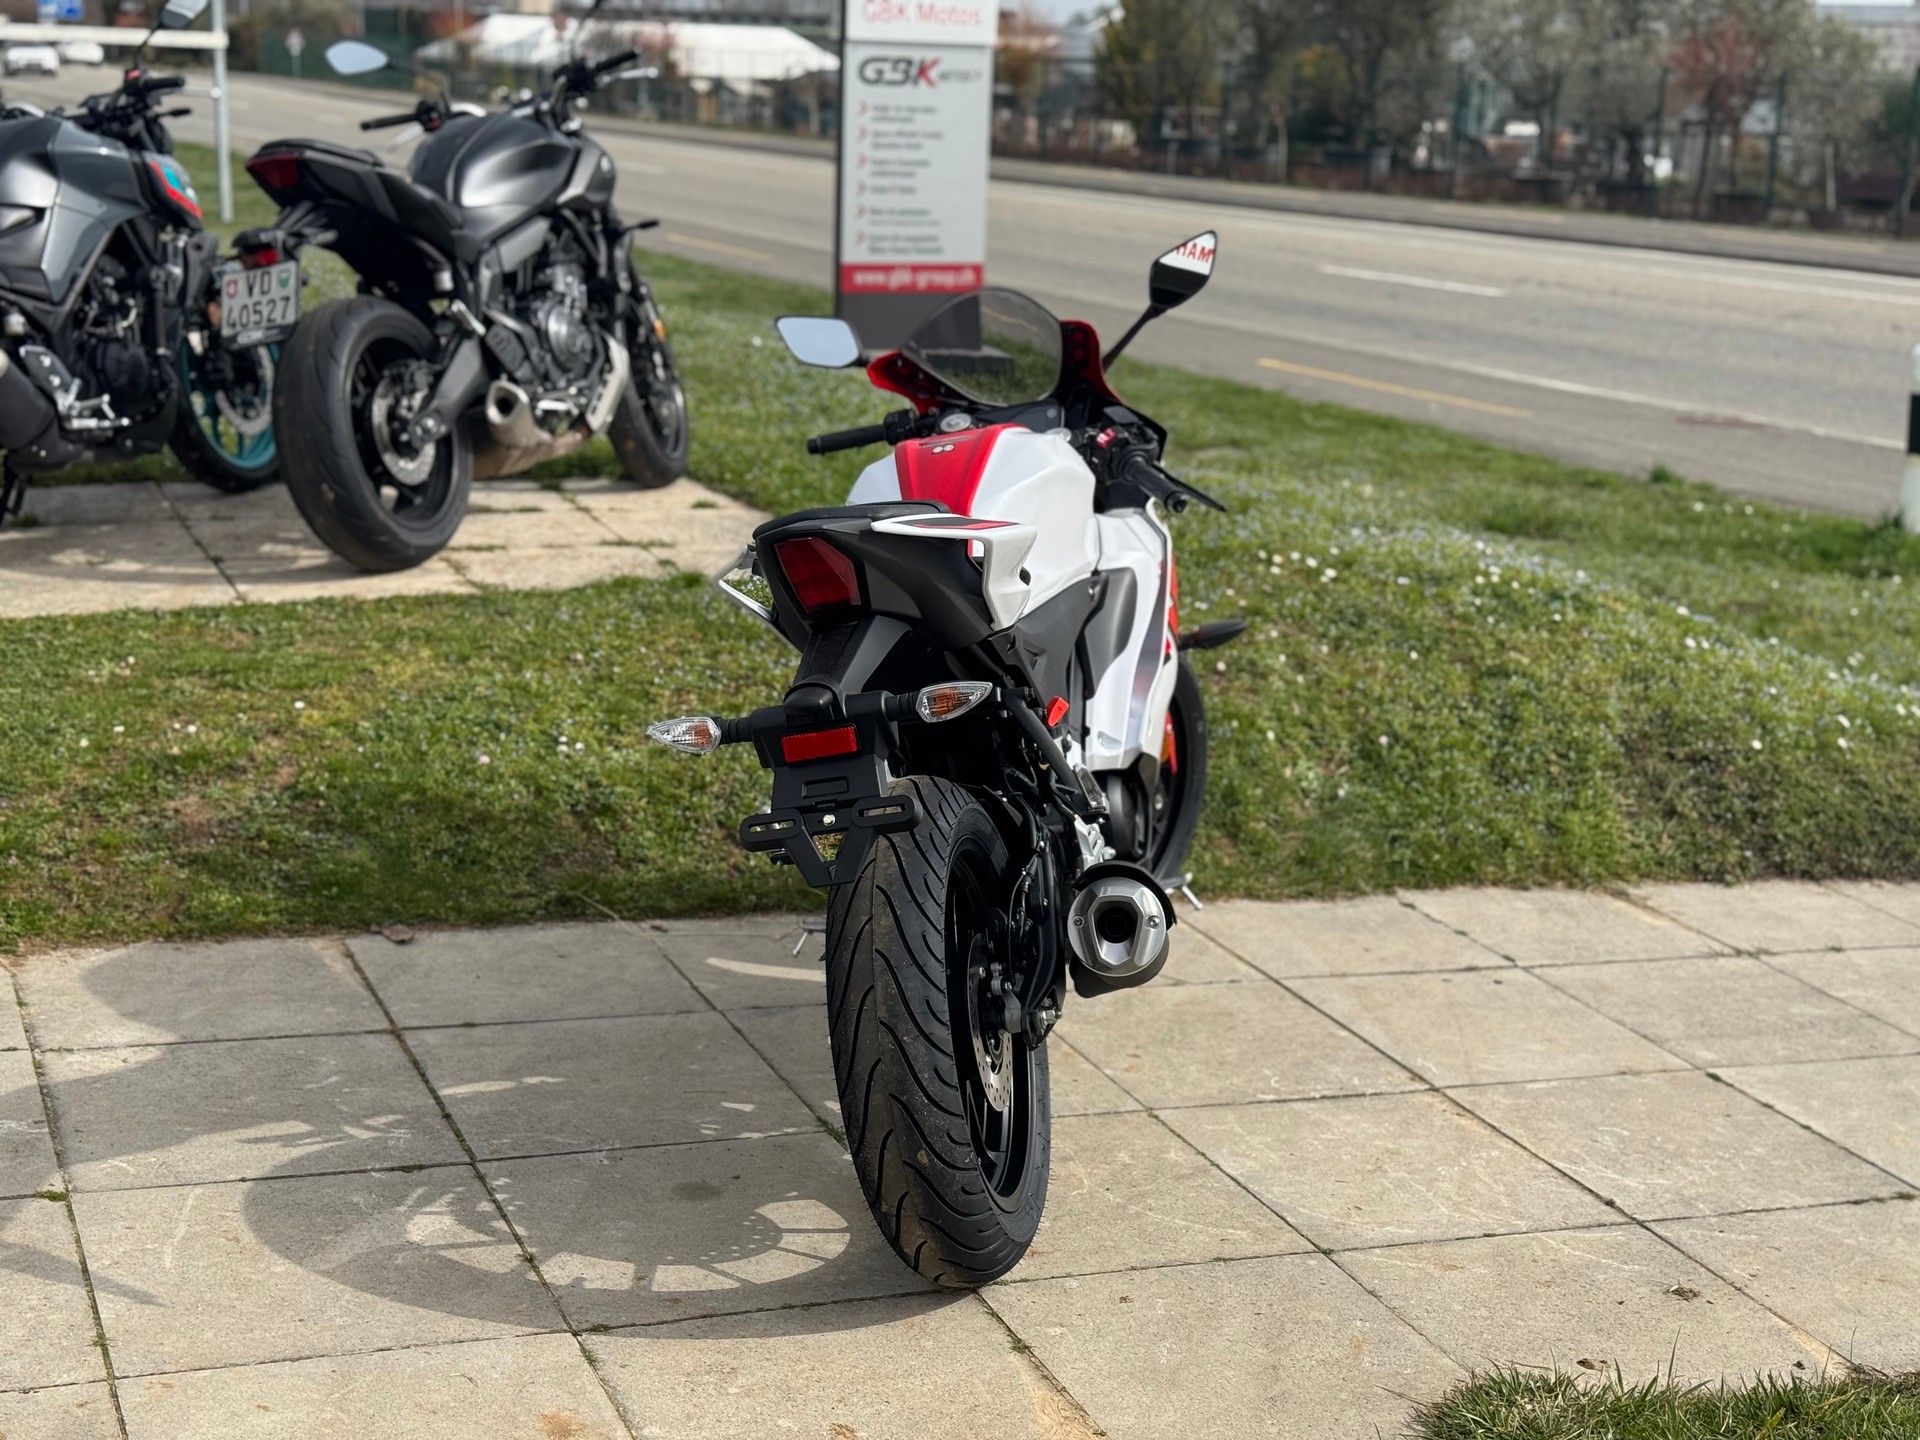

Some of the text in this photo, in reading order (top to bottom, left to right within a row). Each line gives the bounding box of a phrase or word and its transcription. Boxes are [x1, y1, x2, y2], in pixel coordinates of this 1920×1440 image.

[858, 57, 942, 89] GBK
[246, 270, 272, 298] VD
[226, 296, 291, 329] 40527
